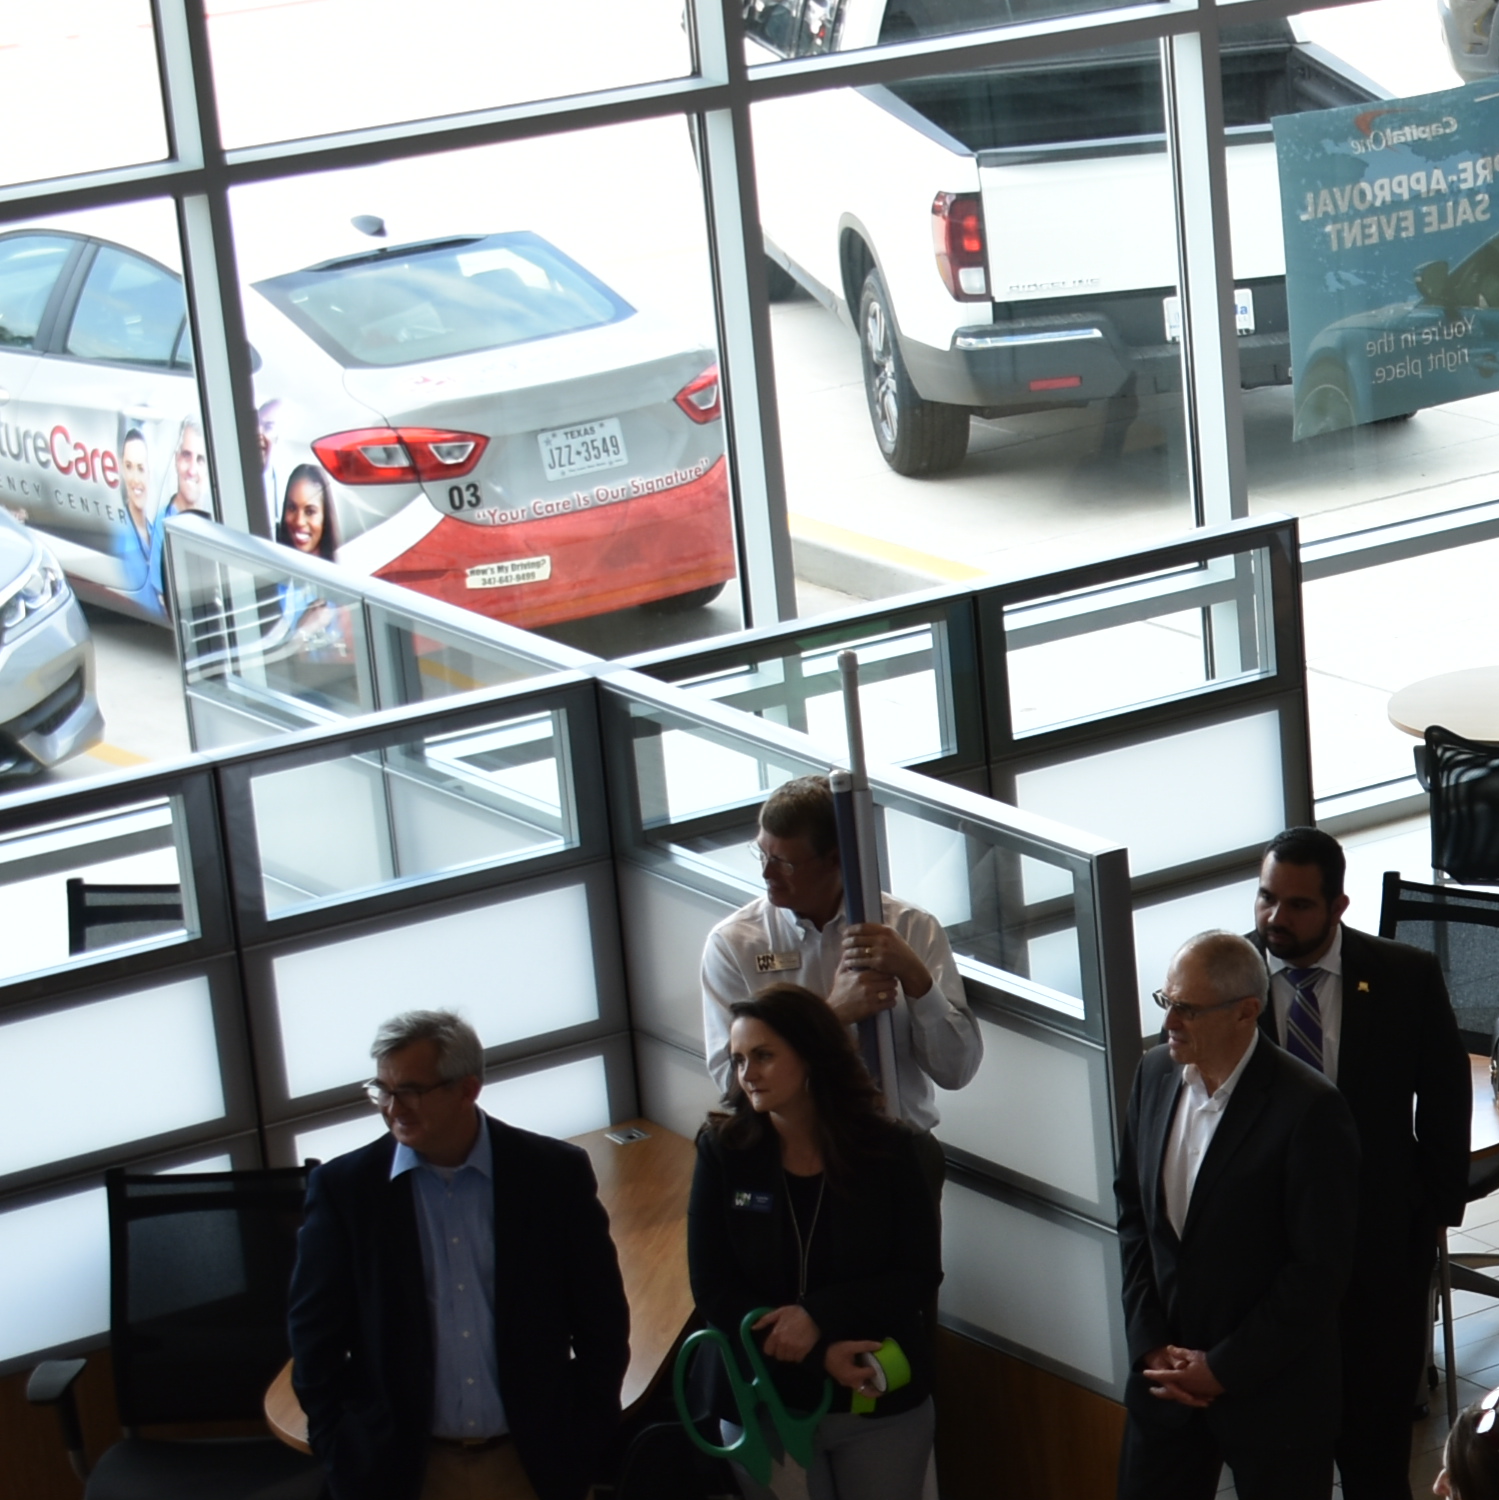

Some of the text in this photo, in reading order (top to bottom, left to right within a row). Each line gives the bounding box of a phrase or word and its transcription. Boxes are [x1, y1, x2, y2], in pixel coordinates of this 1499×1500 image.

[563, 426, 596, 440] TEXAS
[54, 489, 129, 525] CENTER
[448, 483, 481, 511] 03
[532, 497, 571, 517] Care
[576, 492, 590, 507] Is
[595, 487, 627, 503] Our
[496, 565, 509, 574] My
[510, 558, 547, 573] Driving?
